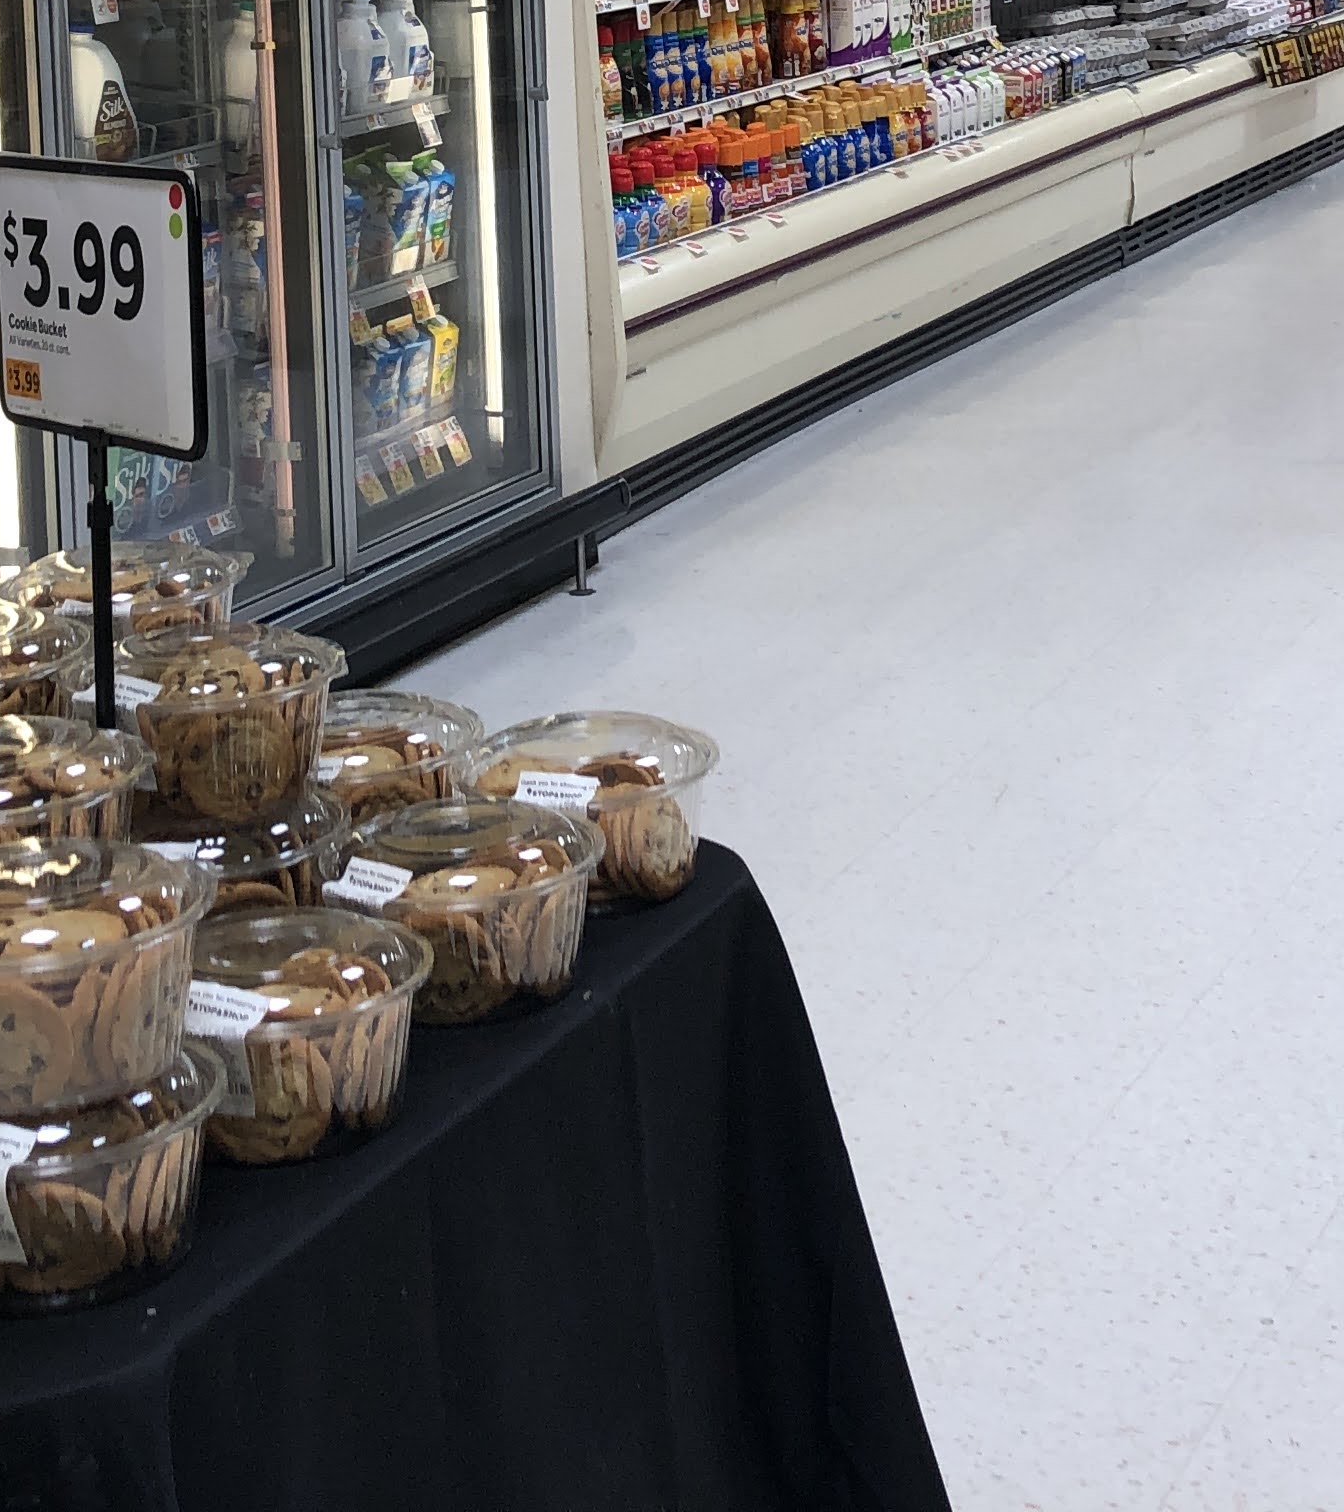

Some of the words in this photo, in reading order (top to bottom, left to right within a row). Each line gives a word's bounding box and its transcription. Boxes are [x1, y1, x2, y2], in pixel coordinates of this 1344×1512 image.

[100, 97, 124, 122] Silk
[3, 210, 144, 321] $3.99
[9, 313, 37, 332] Cookie
[39, 319, 67, 338] Bucket
[9, 368, 40, 393] $3.99
[112, 459, 152, 513] Silk
